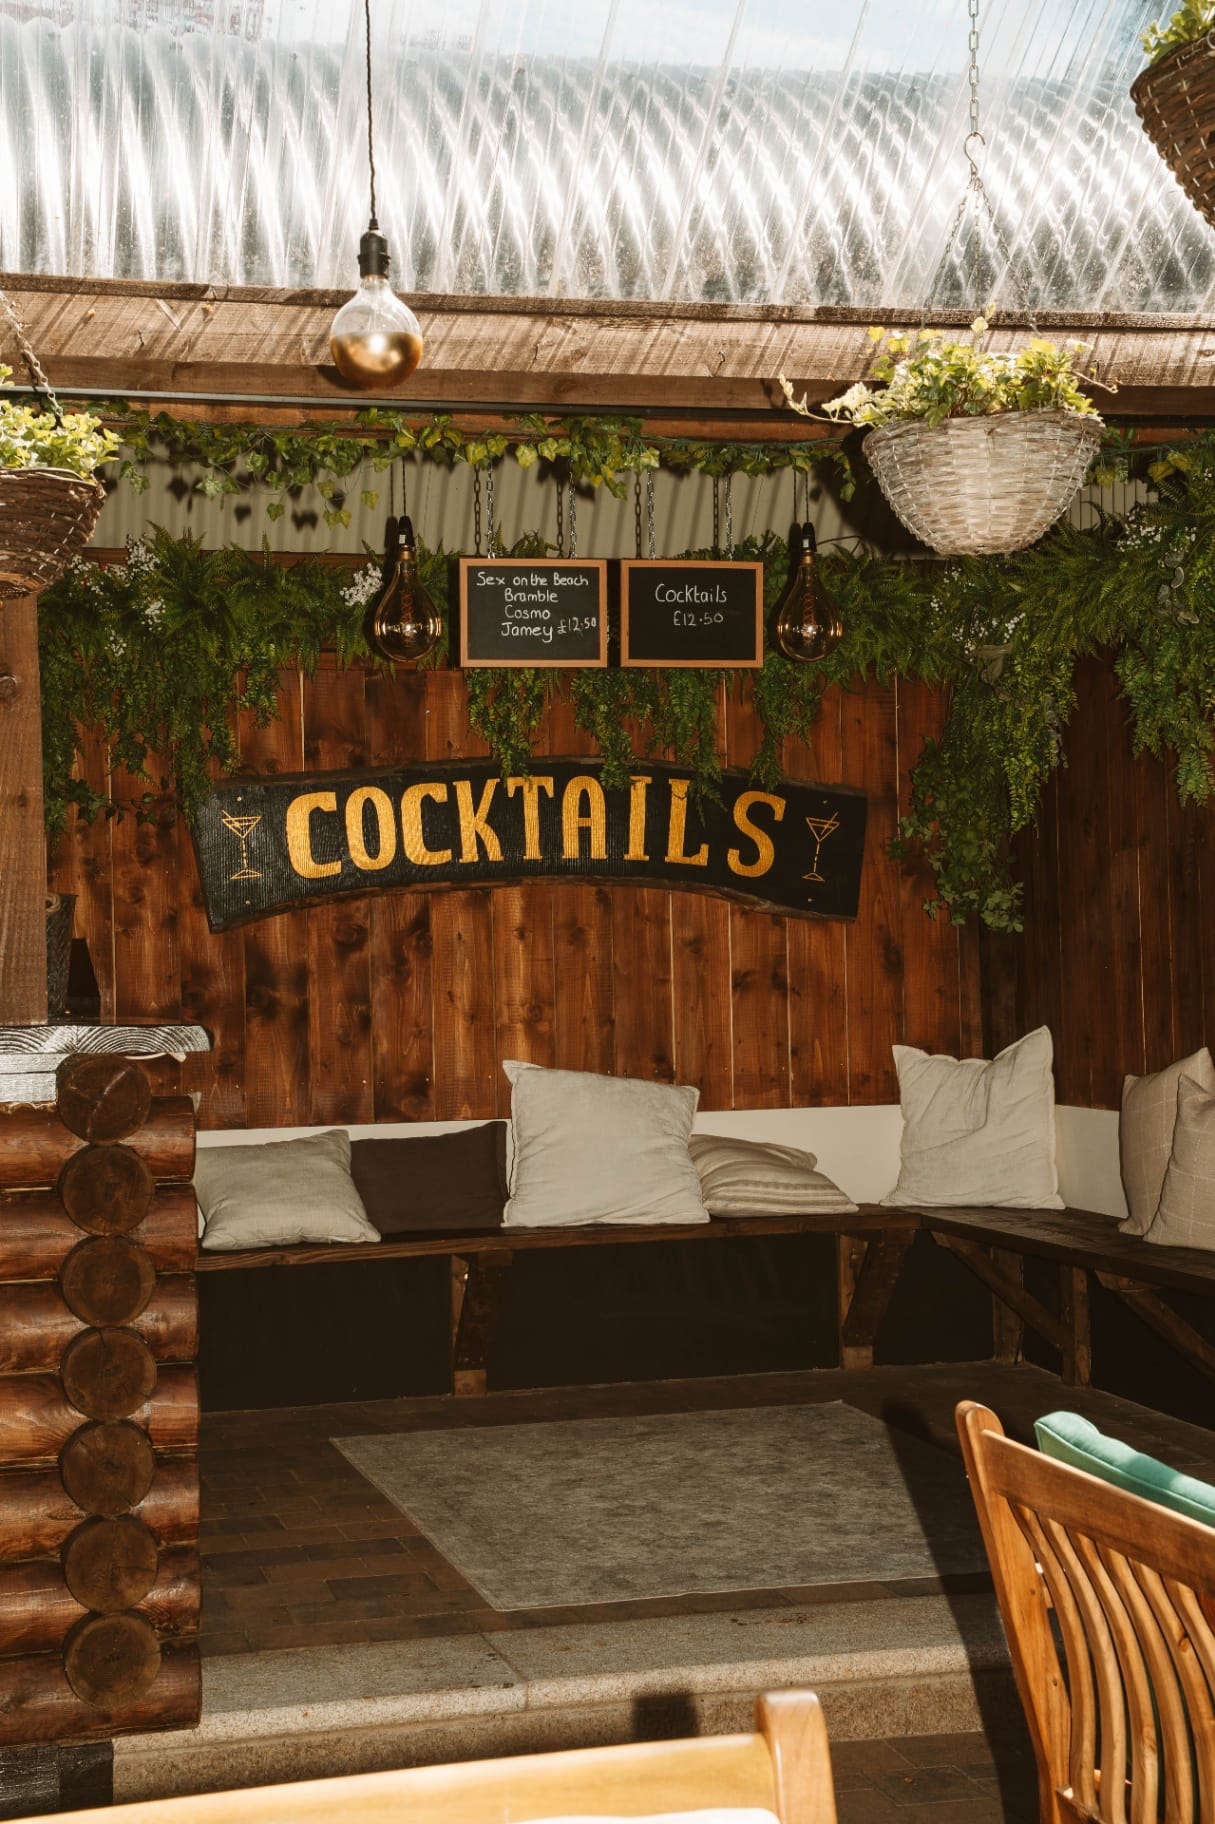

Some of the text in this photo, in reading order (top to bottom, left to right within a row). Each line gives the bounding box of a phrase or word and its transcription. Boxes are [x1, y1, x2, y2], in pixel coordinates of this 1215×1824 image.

[476, 571, 589, 586] Sex on the Beach
[504, 587, 558, 602] Bramble
[655, 583, 727, 603] Cocktails
[504, 604, 550, 620] Cosmo
[286, 775, 786, 879] COCKTAILS
